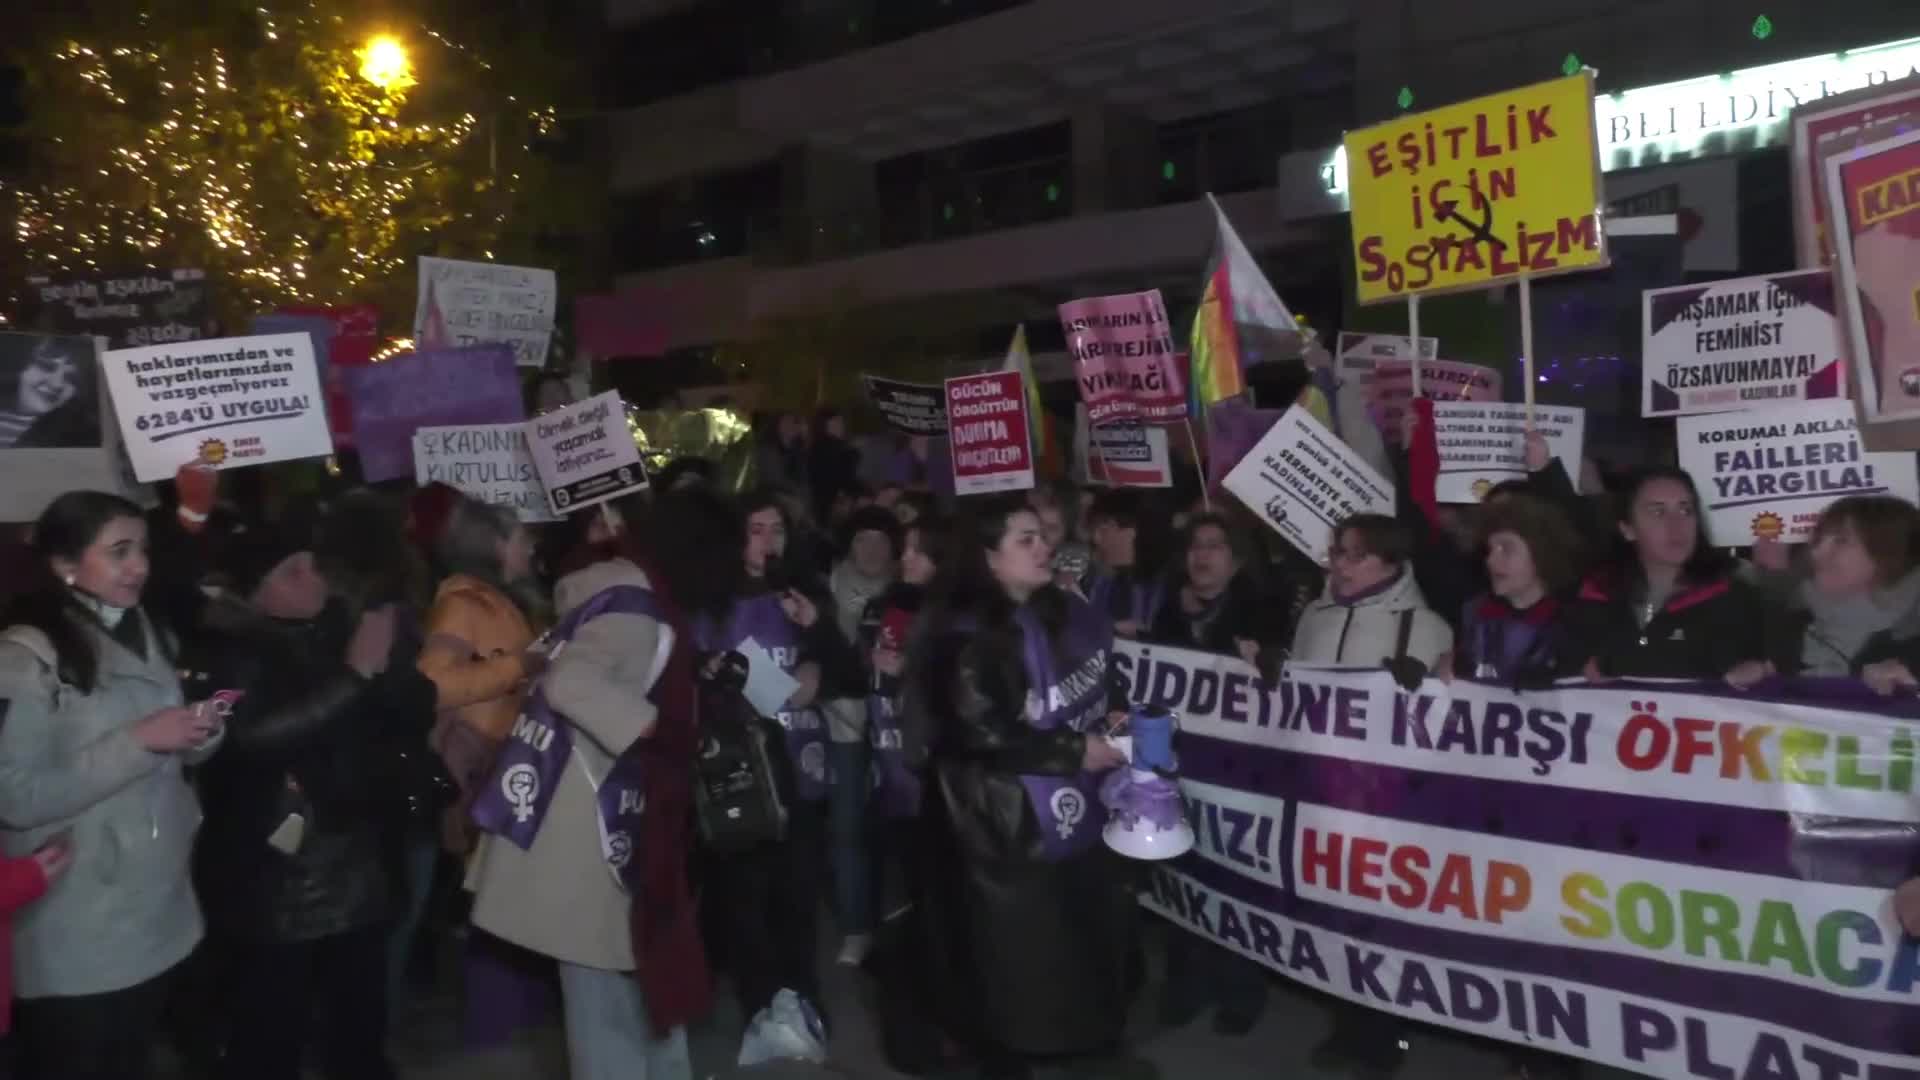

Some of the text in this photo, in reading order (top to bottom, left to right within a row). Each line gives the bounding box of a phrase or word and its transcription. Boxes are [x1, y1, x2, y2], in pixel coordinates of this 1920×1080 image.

[1366, 102, 1557, 178] EŞİTLİK
[1411, 166, 1517, 230] İÇİN
[1359, 213, 1599, 294] SOSYALİZM
[1672, 290, 1761, 327] AŞAMAK
[1695, 322, 1784, 353] FEMİNİST
[126, 346, 295, 373] haklarımızdan ve
[136, 361, 294, 388] hayatlarımızdan
[1666, 354, 1816, 389] ÖZSAVUNMAYA!
[149, 377, 289, 402] vazgeçmiyoruz
[135, 396, 310, 431] 6284'Ü UYGULA!
[1698, 424, 1787, 444] KORUMA!
[1713, 433, 1861, 474] FAİLLERİ
[1262, 455, 1328, 511] KADINLARA
[1711, 465, 1875, 499] YARGILA!
[1391, 690, 1594, 777] KARŞI
[1302, 827, 1533, 925] HESAP
[1344, 943, 1590, 1050] KADIN
[1620, 1002, 1920, 1080] PLAT
